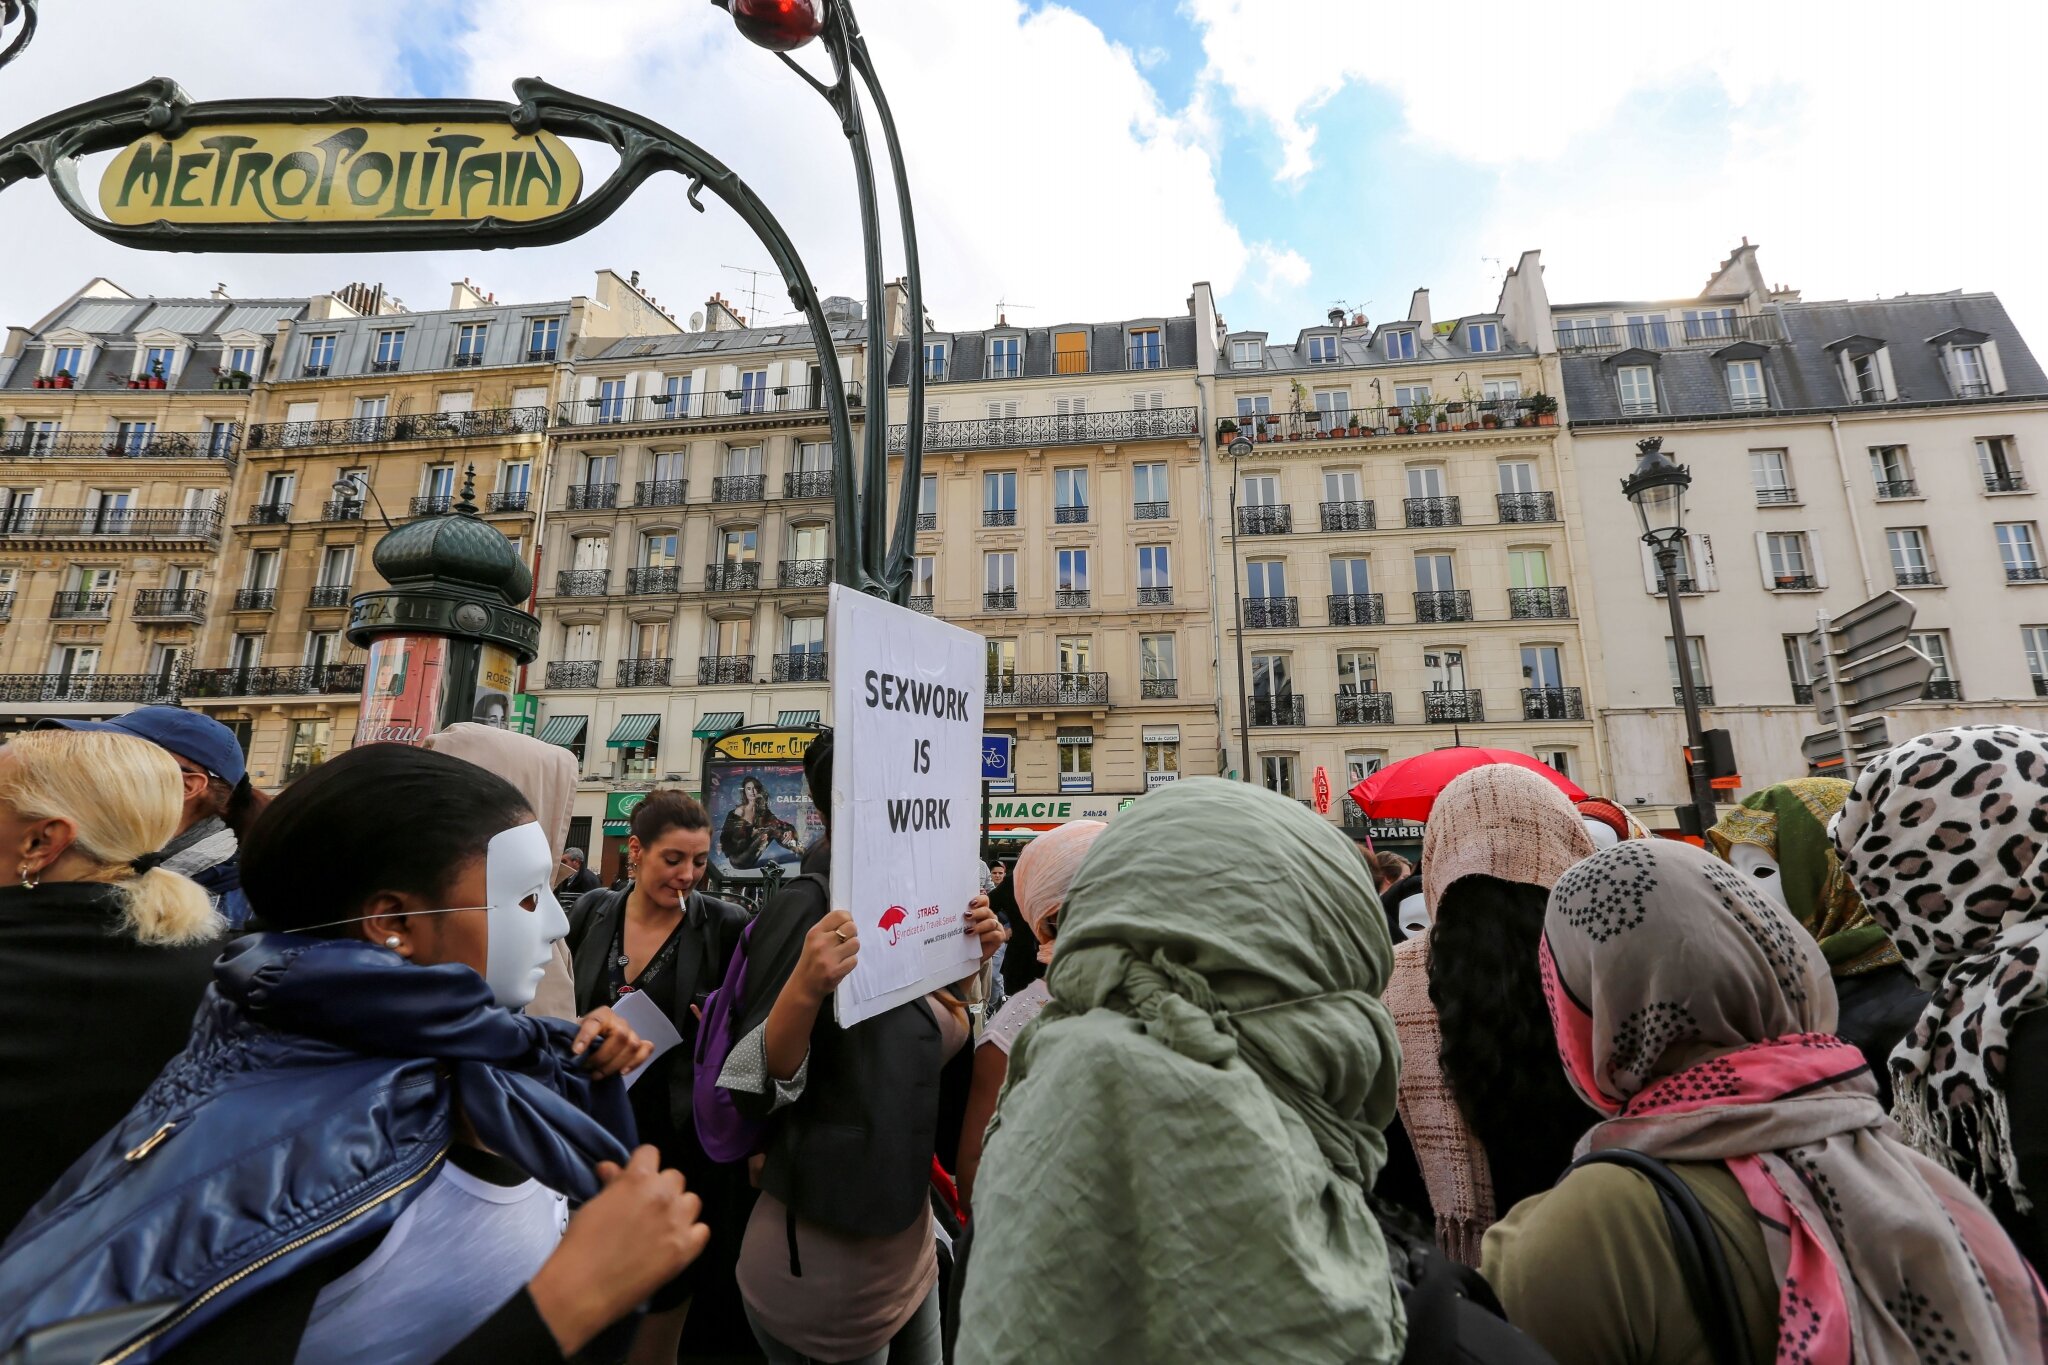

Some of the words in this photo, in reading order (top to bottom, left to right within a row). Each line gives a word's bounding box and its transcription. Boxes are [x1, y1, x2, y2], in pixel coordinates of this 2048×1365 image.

[116, 127, 562, 220] METROPOLITAIN
[865, 669, 969, 722] SEXWORK
[742, 736, 774, 756] PLACE
[913, 738, 931, 775] IS
[1319, 769, 1328, 814] TABAC
[887, 797, 951, 834] WORK
[917, 905, 939, 919] STRASS
[896, 924, 920, 941] Syndicat
